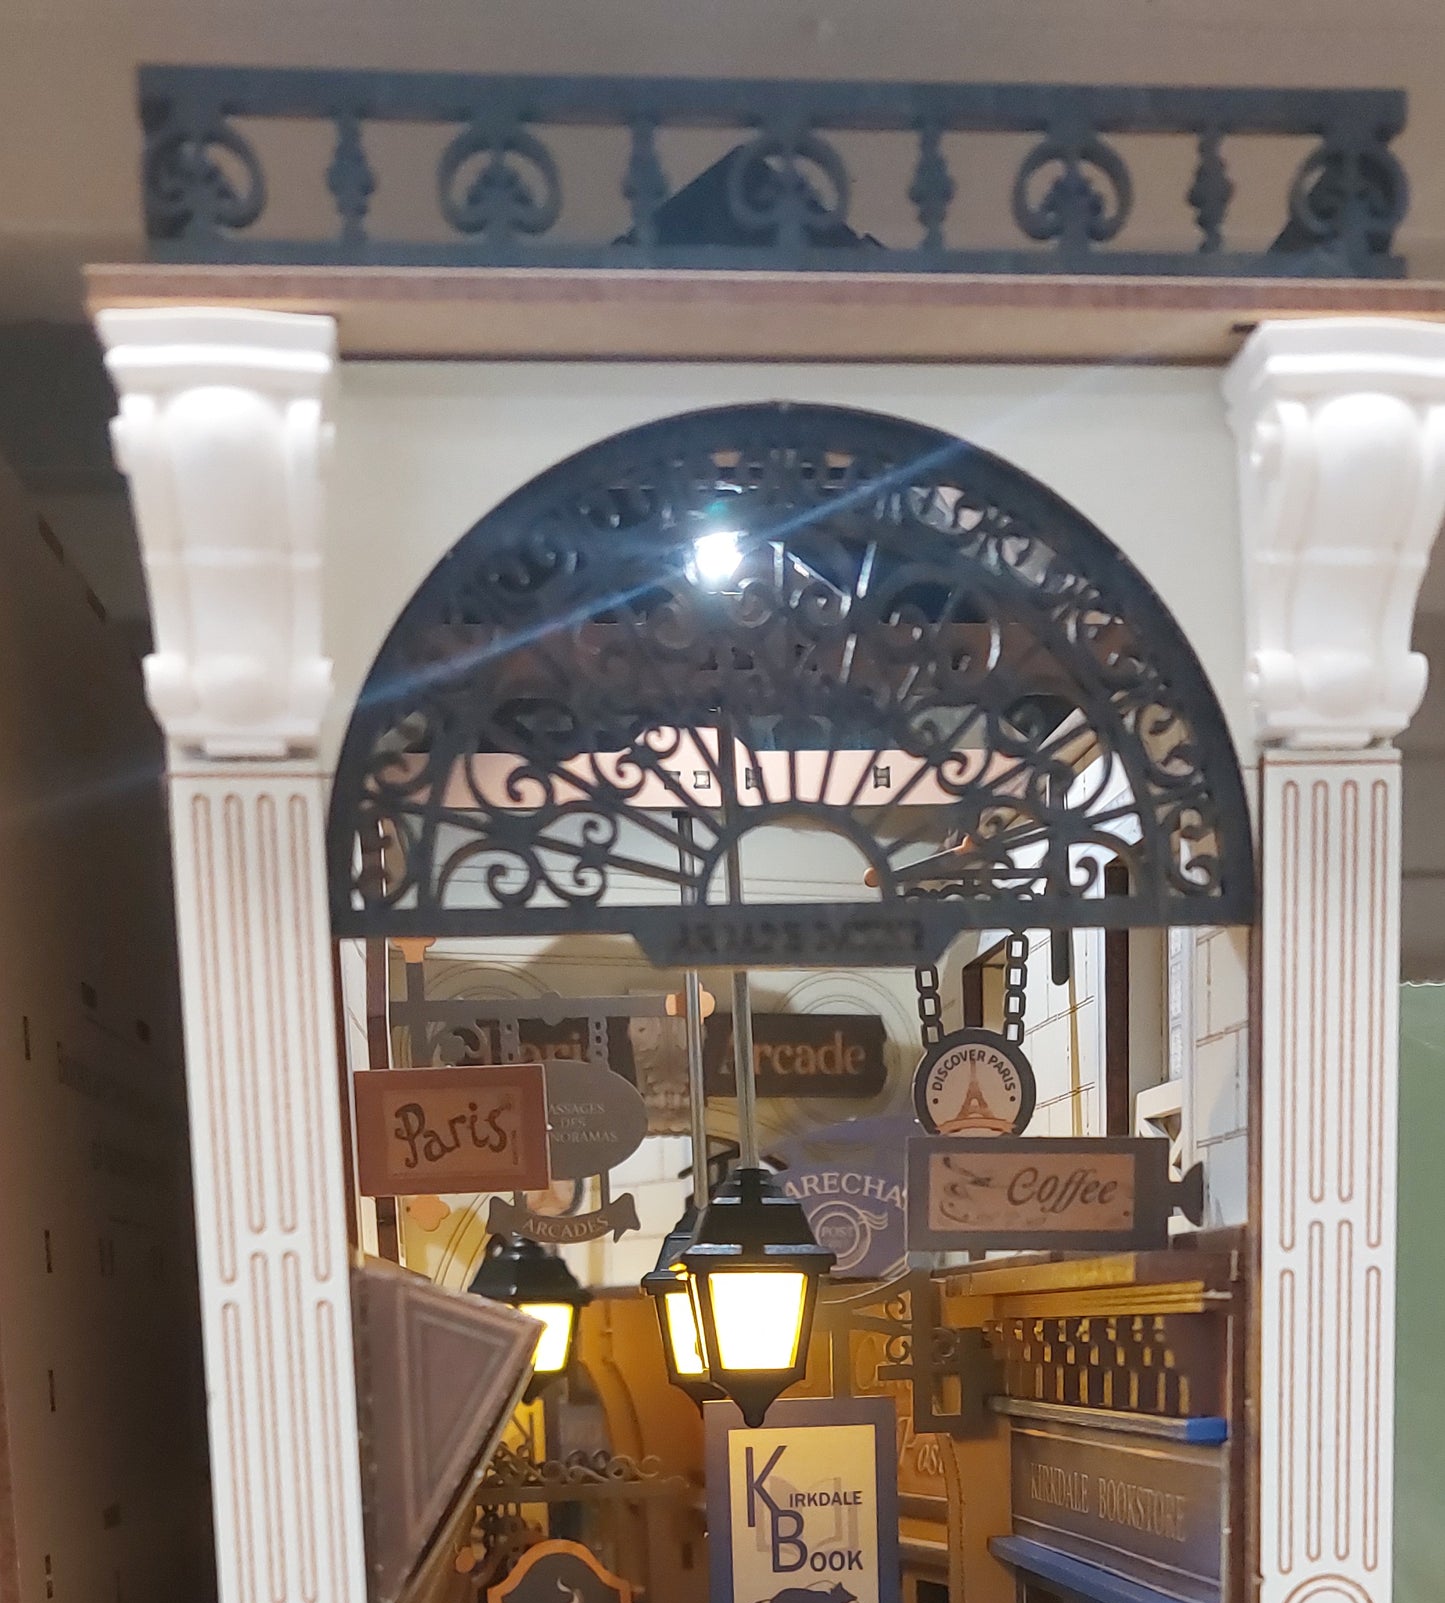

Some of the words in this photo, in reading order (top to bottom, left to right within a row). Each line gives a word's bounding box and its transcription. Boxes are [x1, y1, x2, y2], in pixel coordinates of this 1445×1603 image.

[932, 1048, 986, 1091] DISCOVER
[988, 1055, 1016, 1091] PARIS
[549, 1103, 605, 1115] ASSAGES
[394, 1102, 512, 1169] Paris
[550, 1130, 618, 1144] NORAMAS
[1007, 1166, 1117, 1214] Coffee
[521, 1216, 609, 1240] ARCADES
[745, 1445, 863, 1528] KIRKDALE
[1029, 1462, 1090, 1515] KIRKDALE
[1098, 1477, 1188, 1543] BOOKSTORE
[771, 1509, 864, 1573] BOOK
